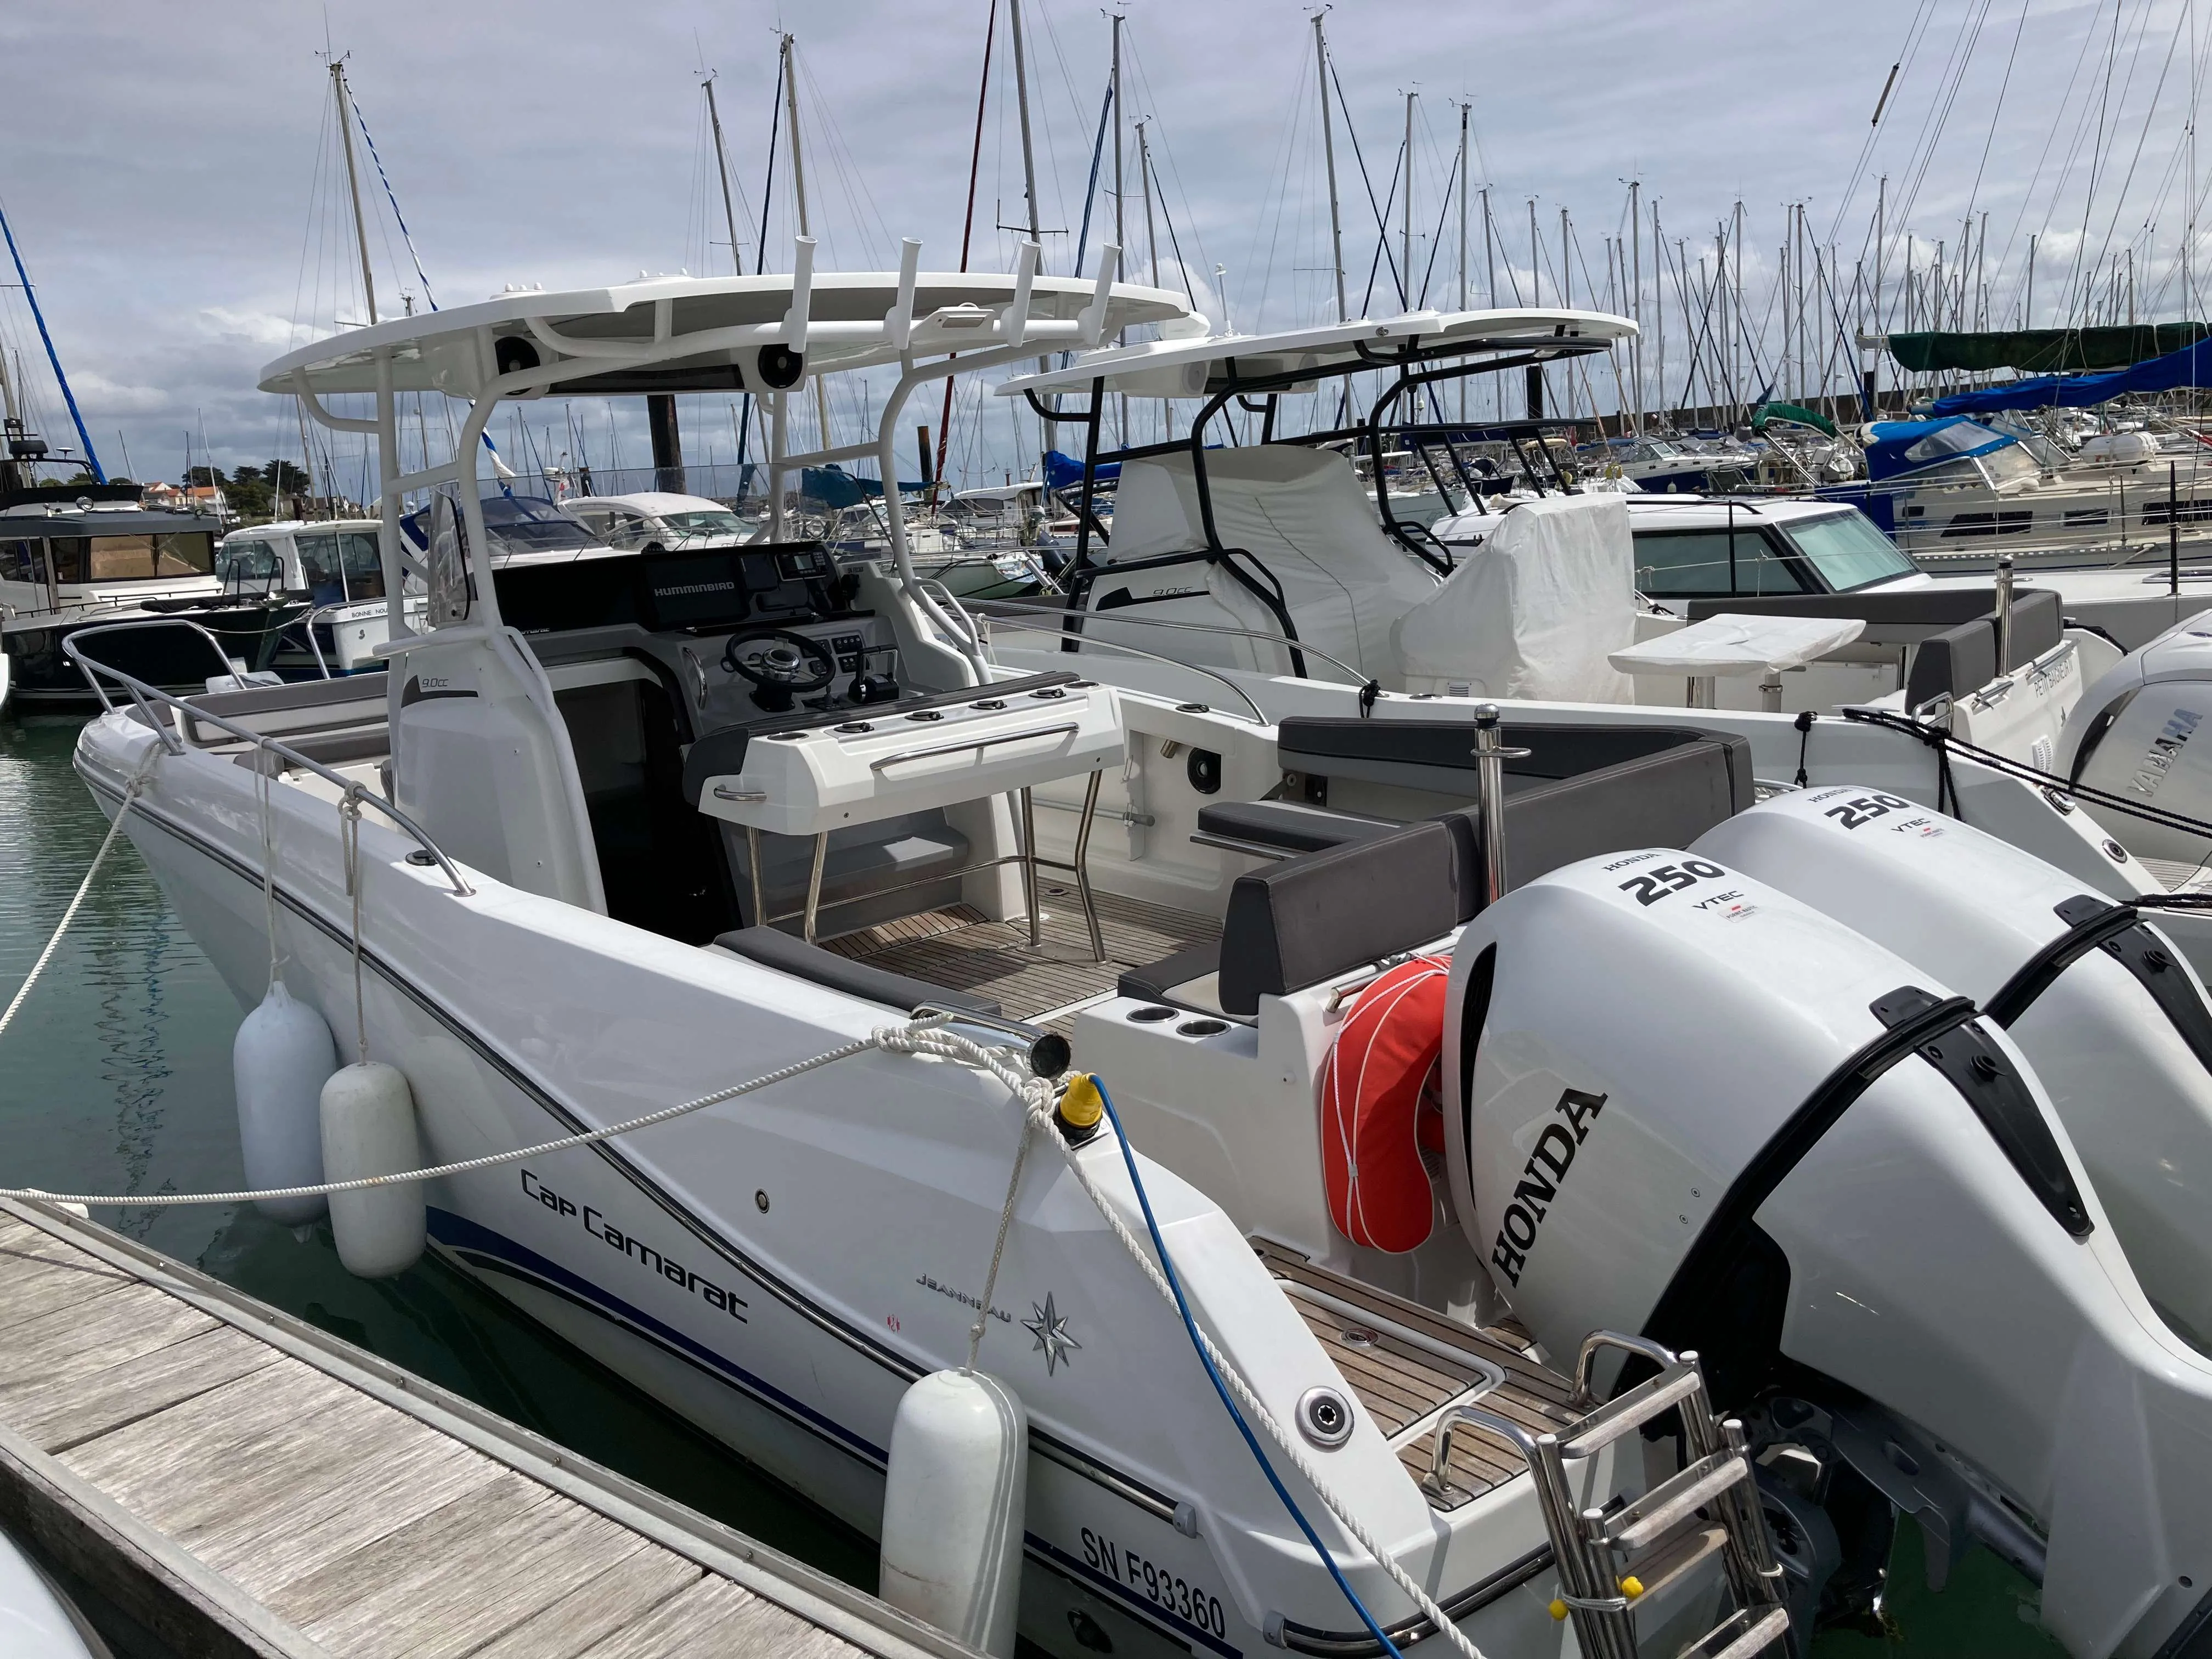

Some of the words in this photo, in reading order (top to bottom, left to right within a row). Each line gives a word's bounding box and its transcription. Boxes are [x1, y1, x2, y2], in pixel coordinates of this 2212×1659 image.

[654, 582, 735, 596] HUMMINBIRD
[2126, 708, 2203, 797] YAMAHA
[1807, 788, 1853, 804] HONDA
[1824, 795, 1910, 830] 250
[1891, 818, 1931, 833] VTEC
[1601, 853, 1662, 871] HONDA
[1617, 860, 1725, 907] 250
[1691, 890, 1745, 910] VTEC
[1491, 1088, 1609, 1289] HONDA
[521, 1169, 577, 1217] Cap
[583, 1205, 748, 1324] Camarat
[916, 1273, 1011, 1323] JEANNEAU
[1081, 1527, 1120, 1581] SN
[1125, 1549, 1226, 1640] F93360
